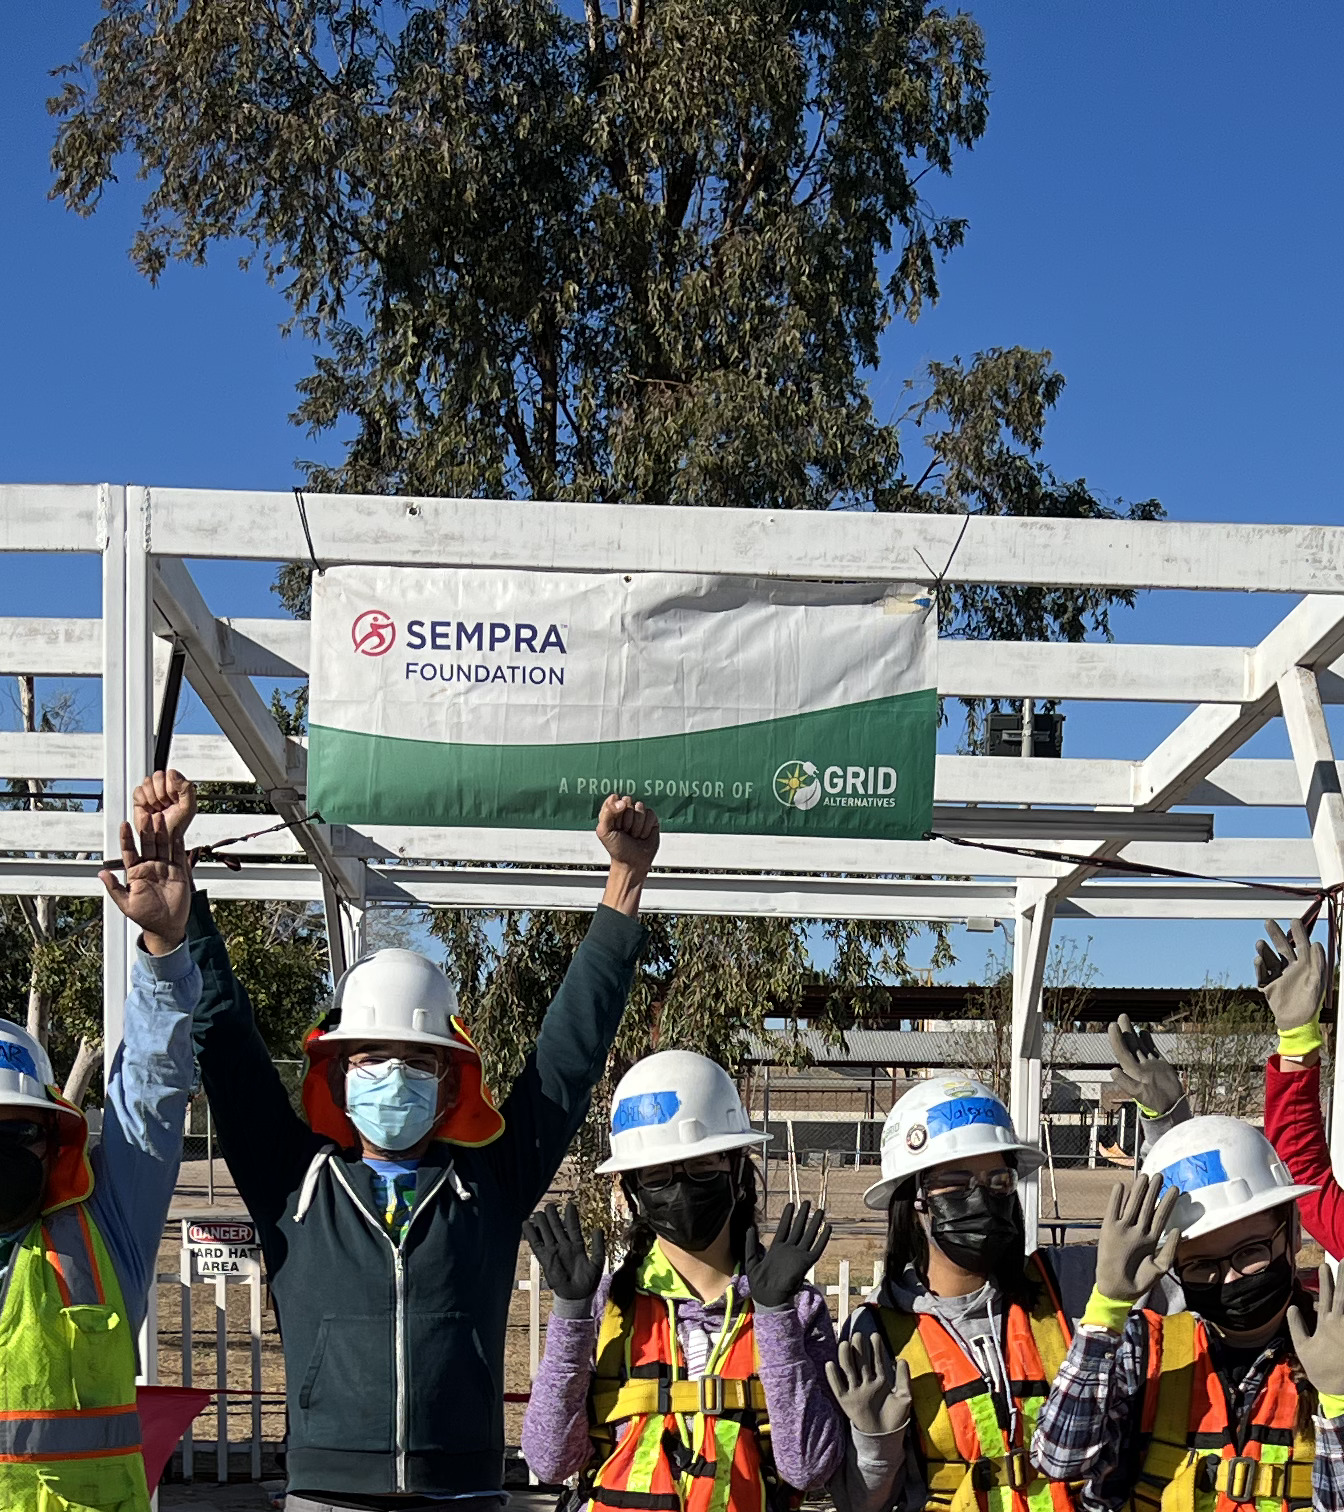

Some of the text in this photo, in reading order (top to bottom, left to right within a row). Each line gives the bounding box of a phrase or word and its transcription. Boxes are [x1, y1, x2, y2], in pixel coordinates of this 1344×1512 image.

[406, 620, 567, 654] SEMPRA
[406, 662, 564, 685] FOUNDATION
[559, 778, 754, 799] A PROUD SPONSOR OF
[823, 766, 897, 795] GRID
[823, 797, 896, 808] ALTERNATIVES
[196, 1226, 249, 1240] DANGER
[228, 1247, 255, 1259] HAT
[202, 1261, 240, 1272] AREA
